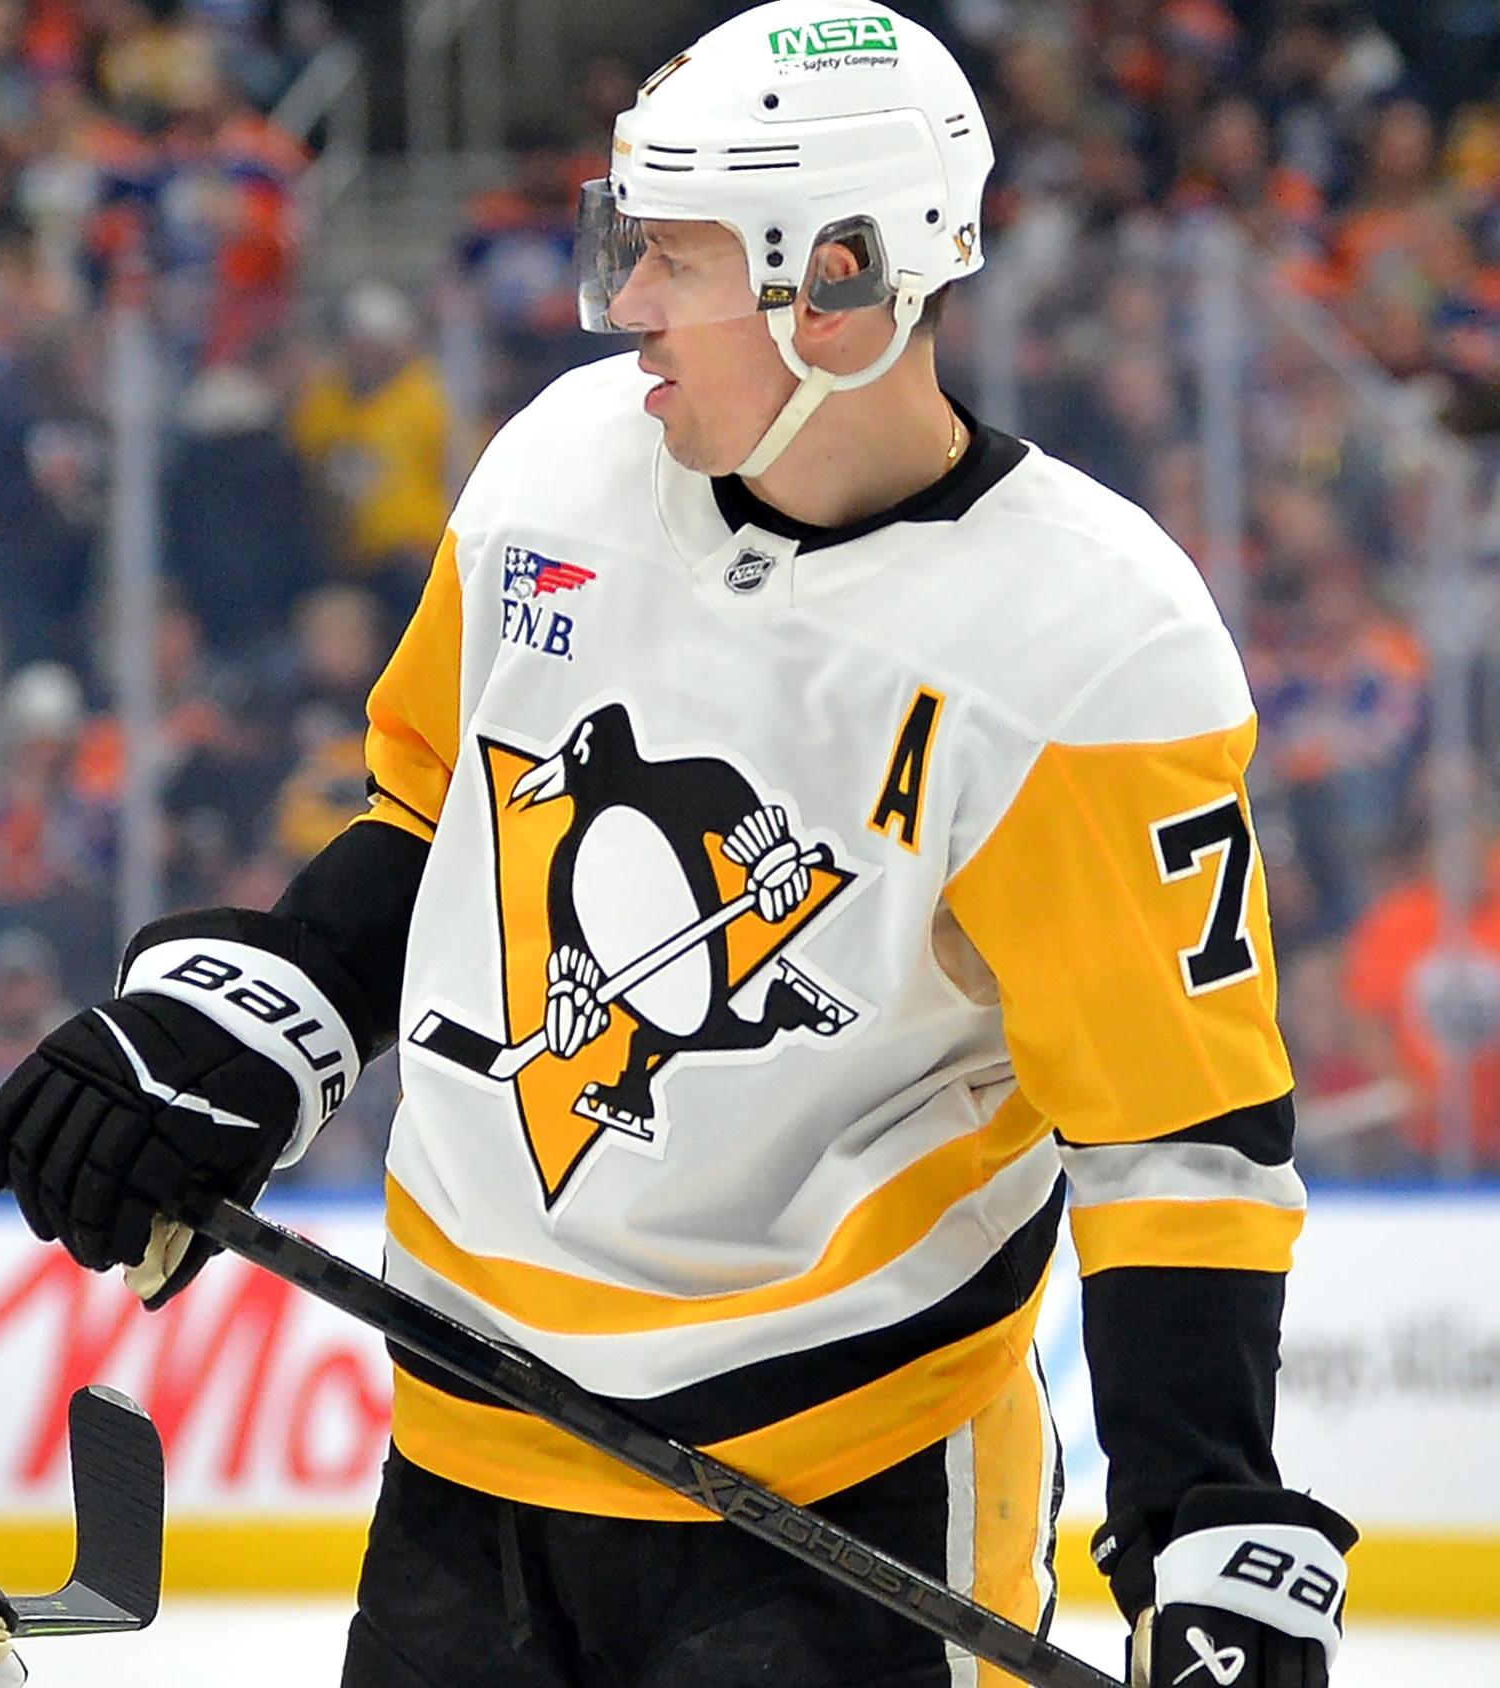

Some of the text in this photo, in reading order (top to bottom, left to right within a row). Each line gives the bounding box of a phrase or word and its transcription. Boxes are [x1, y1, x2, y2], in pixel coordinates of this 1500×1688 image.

[771, 17, 897, 55] MSA
[803, 58, 840, 70] Safety
[844, 55, 898, 67] Company
[867, 684, 945, 855] A
[1149, 792, 1260, 997] 7
[160, 954, 346, 1122] Baue
[779, 1511, 941, 1609] GHOST
[1220, 1541, 1342, 1616] Ba
